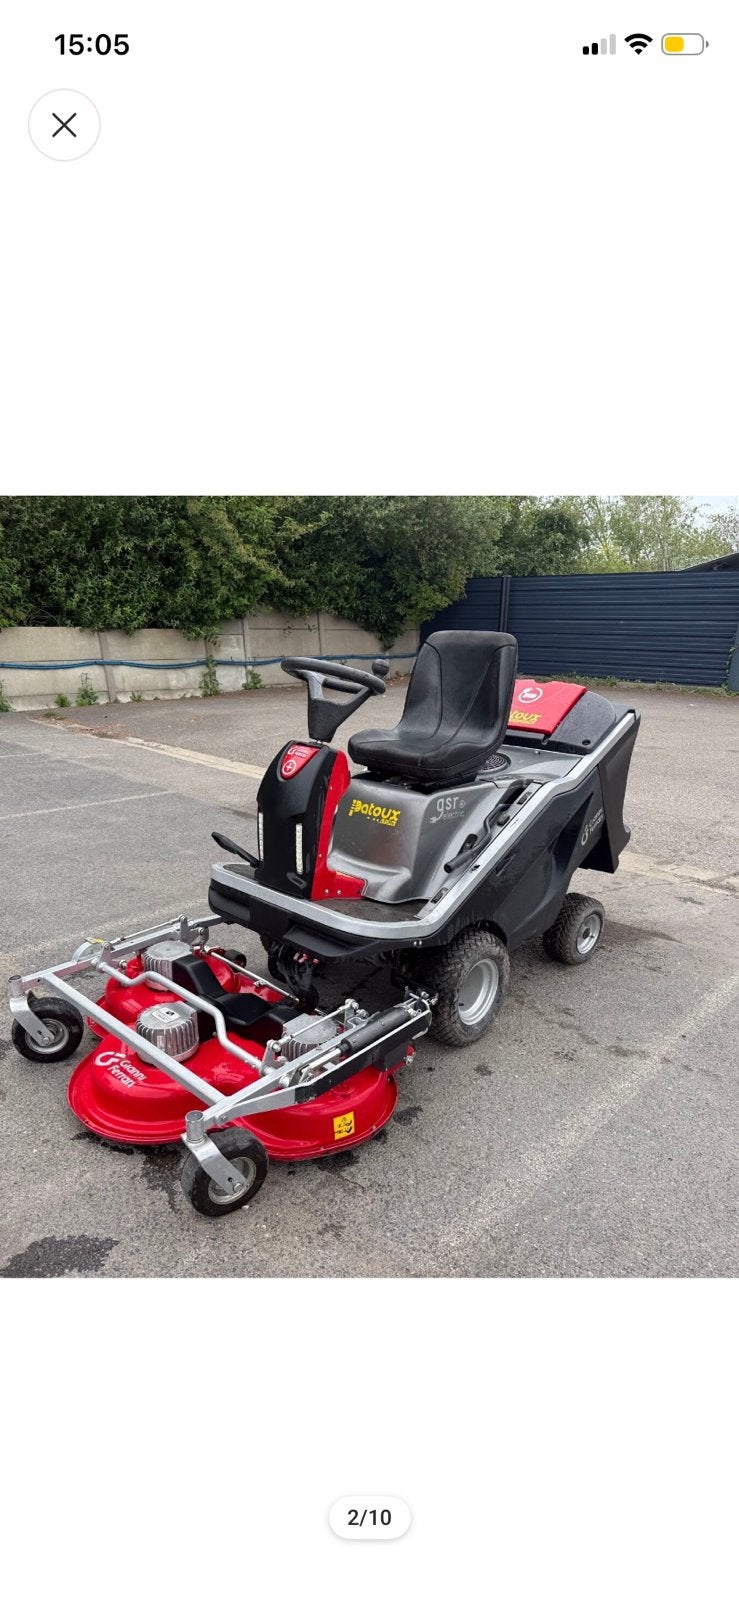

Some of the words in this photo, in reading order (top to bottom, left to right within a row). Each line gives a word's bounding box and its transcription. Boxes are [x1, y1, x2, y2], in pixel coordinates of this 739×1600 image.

[433, 796, 460, 821] gsr
[442, 810, 466, 821] electric
[107, 1065, 136, 1088] Ferrari
[120, 1060, 147, 1081] Gianni
